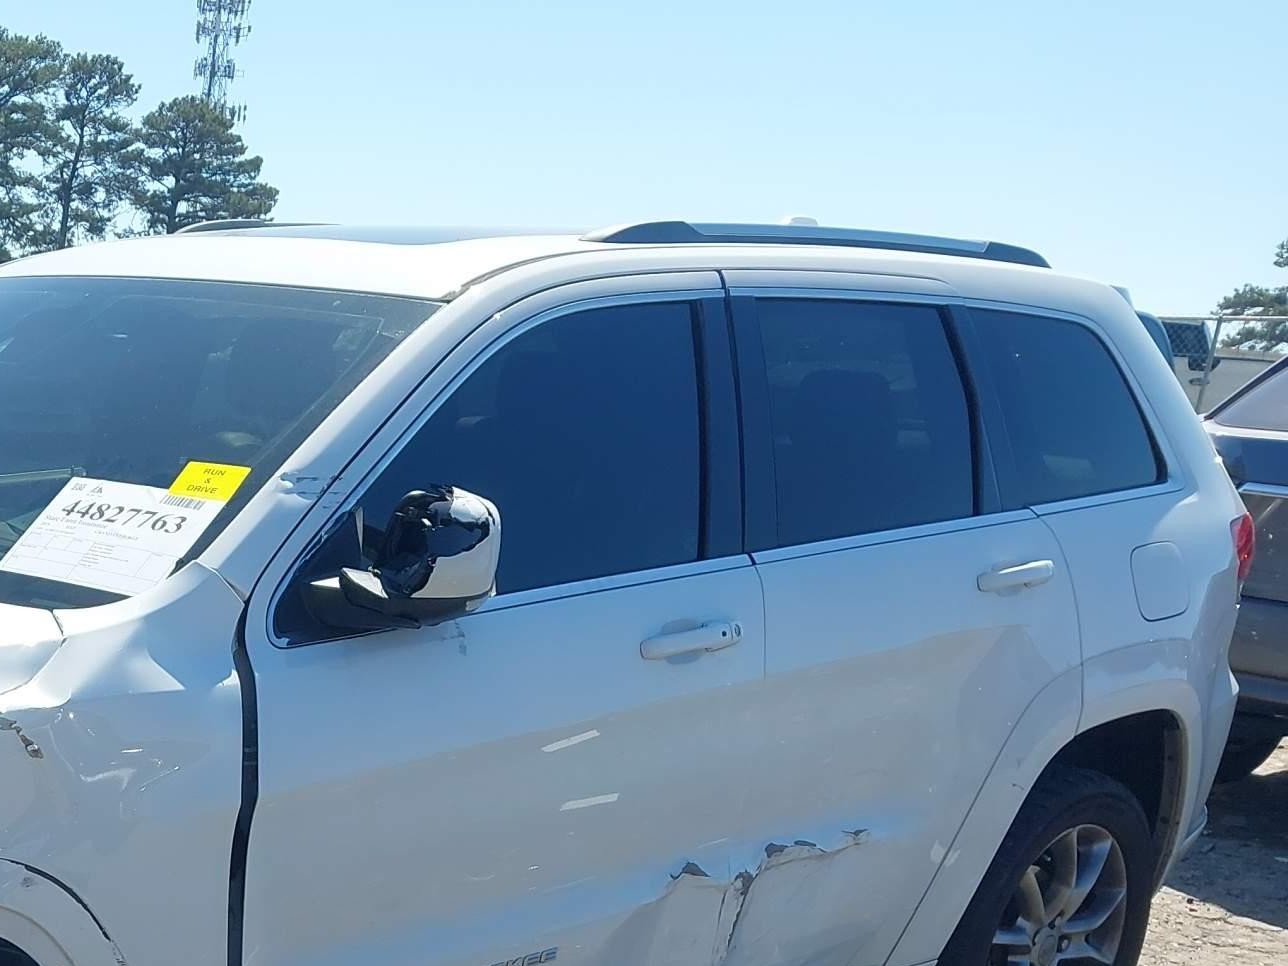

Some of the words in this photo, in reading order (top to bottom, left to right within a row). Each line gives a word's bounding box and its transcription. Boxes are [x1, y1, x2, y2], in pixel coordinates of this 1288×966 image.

[203, 468, 226, 476] RUN
[186, 484, 218, 494] DRIVE
[62, 499, 187, 534] 44827763
